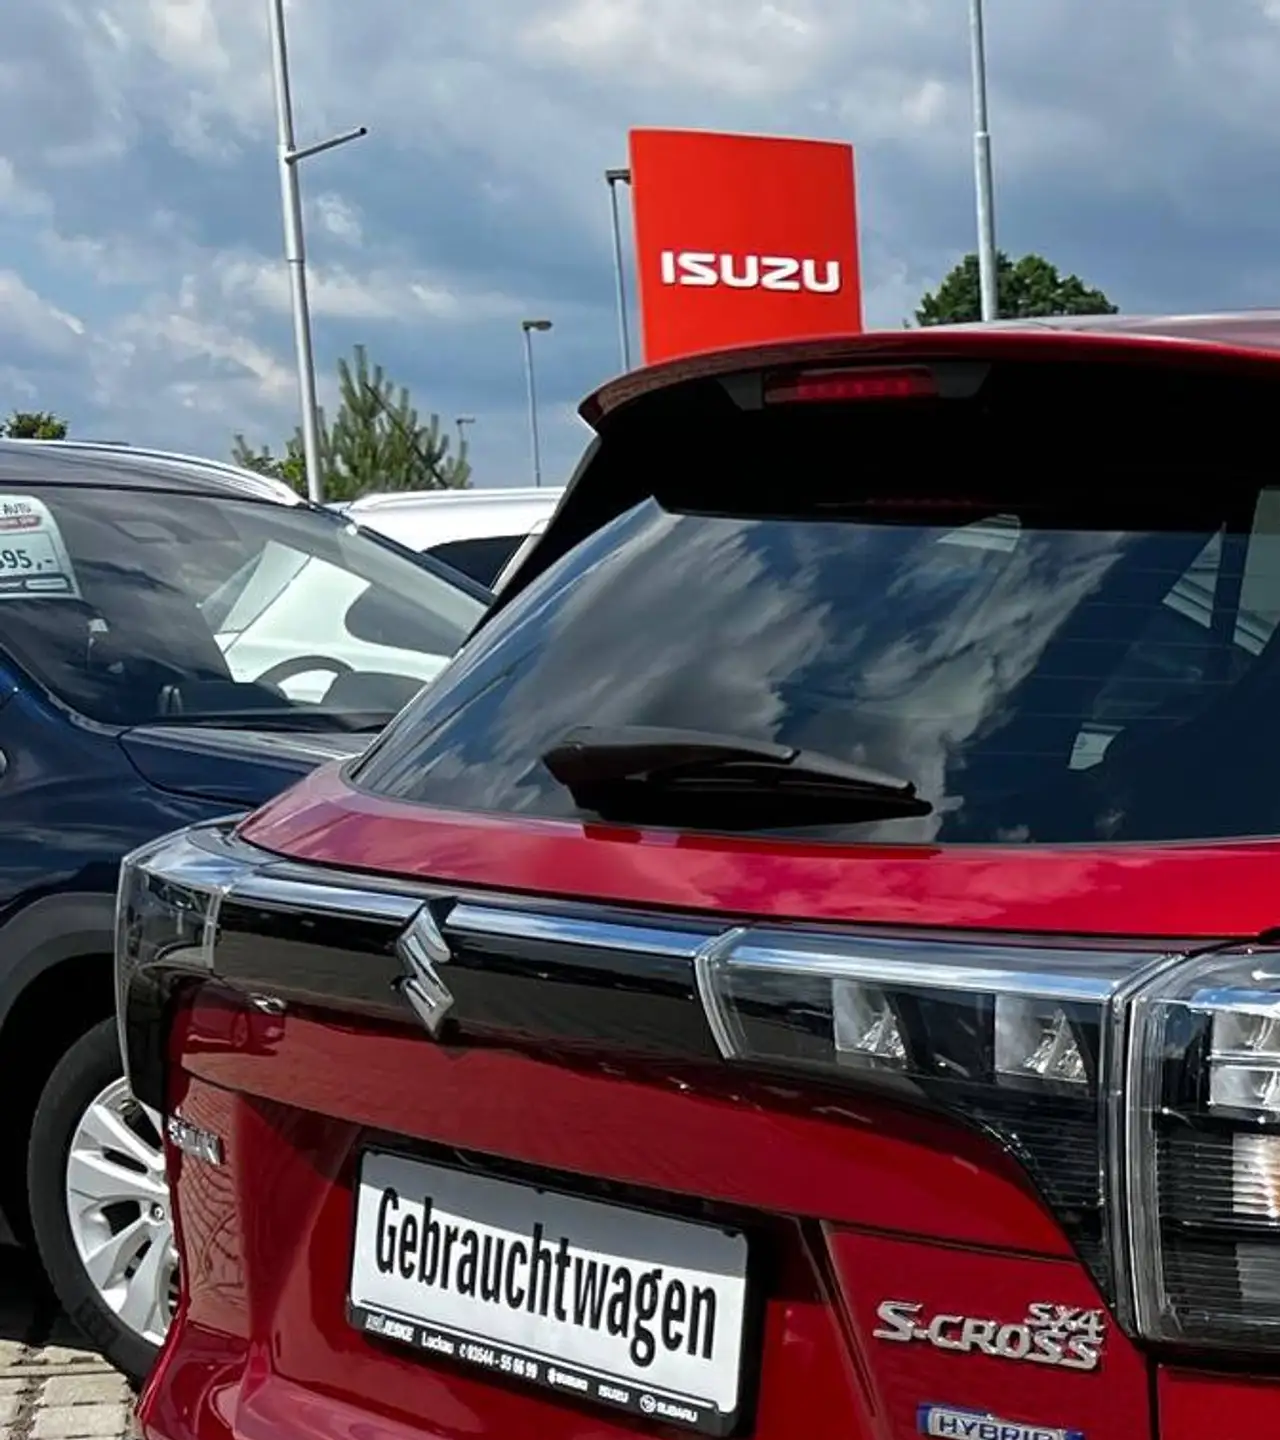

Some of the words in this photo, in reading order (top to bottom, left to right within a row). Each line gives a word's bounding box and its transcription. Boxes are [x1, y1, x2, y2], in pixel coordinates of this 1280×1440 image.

[660, 250, 841, 293] ISUZU
[375, 1187, 717, 1367] Gebrauchtwagen
[873, 1300, 1102, 1370] S-CROSS
[1024, 1303, 1104, 1341] SX4
